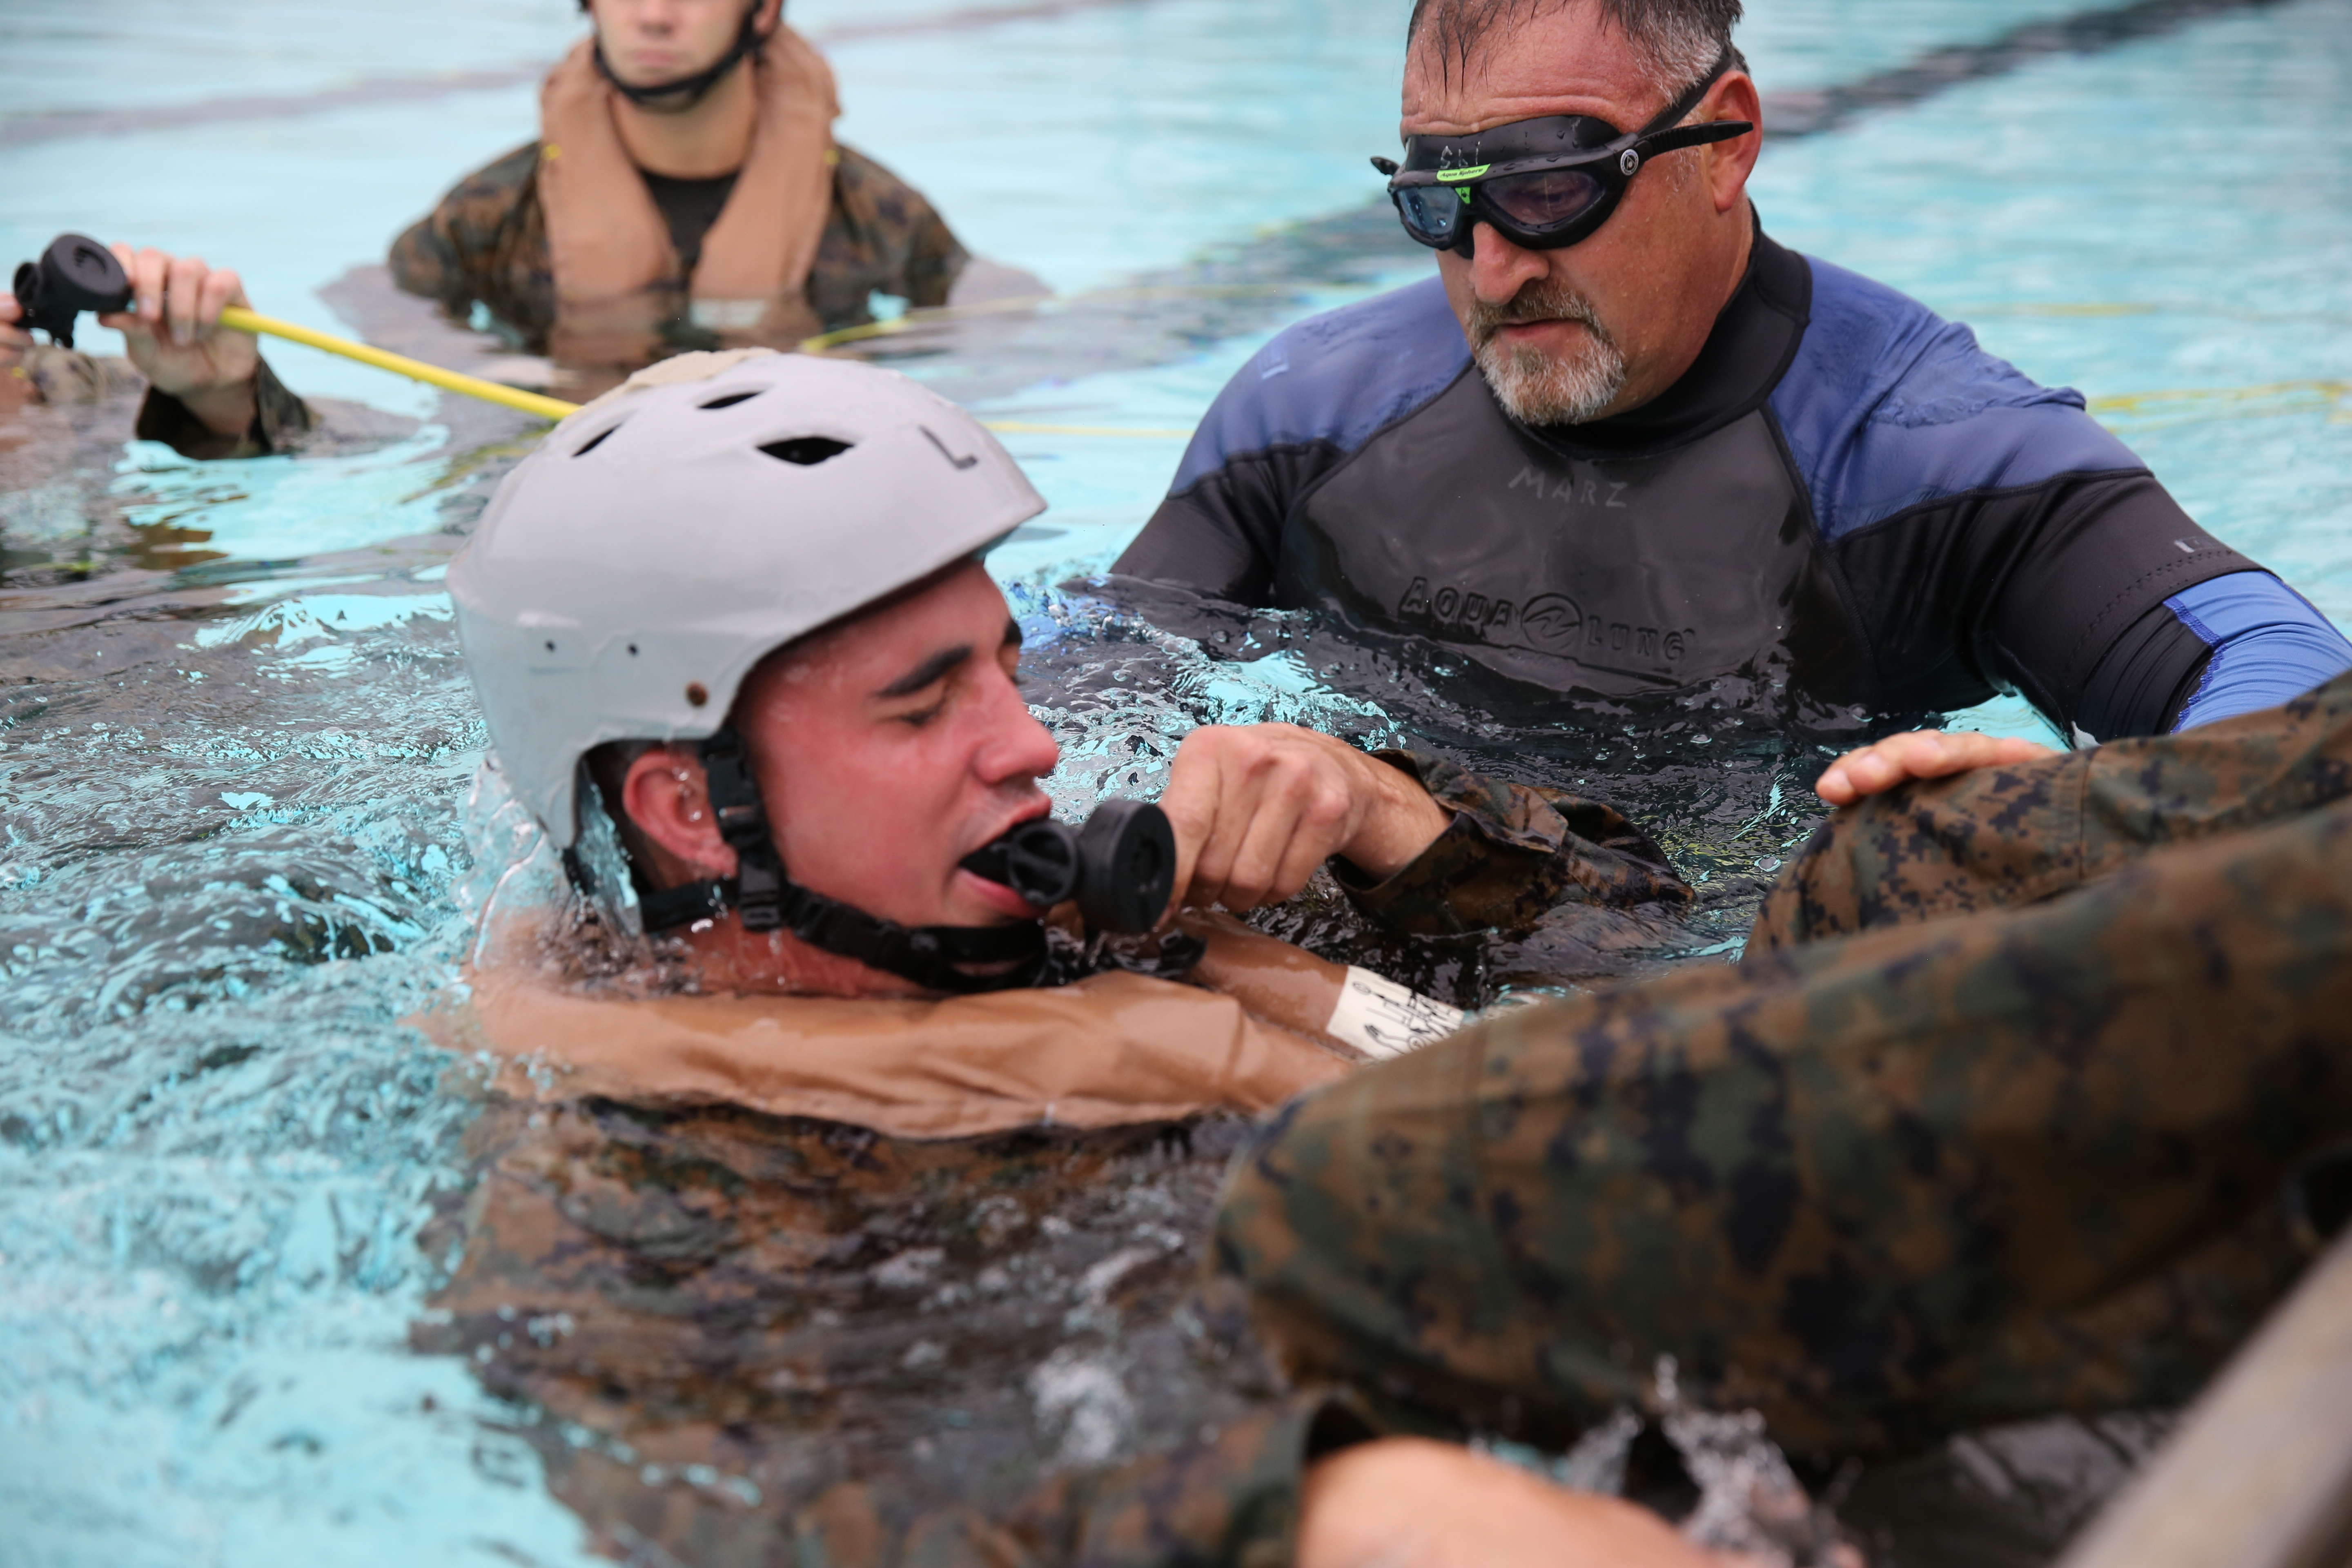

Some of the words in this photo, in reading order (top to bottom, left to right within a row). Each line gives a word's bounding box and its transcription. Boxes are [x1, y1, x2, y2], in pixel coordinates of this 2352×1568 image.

[1508, 466, 1628, 507] MARZ
[1399, 576, 1515, 629] AQUA
[1588, 615, 1686, 660] LUNG
